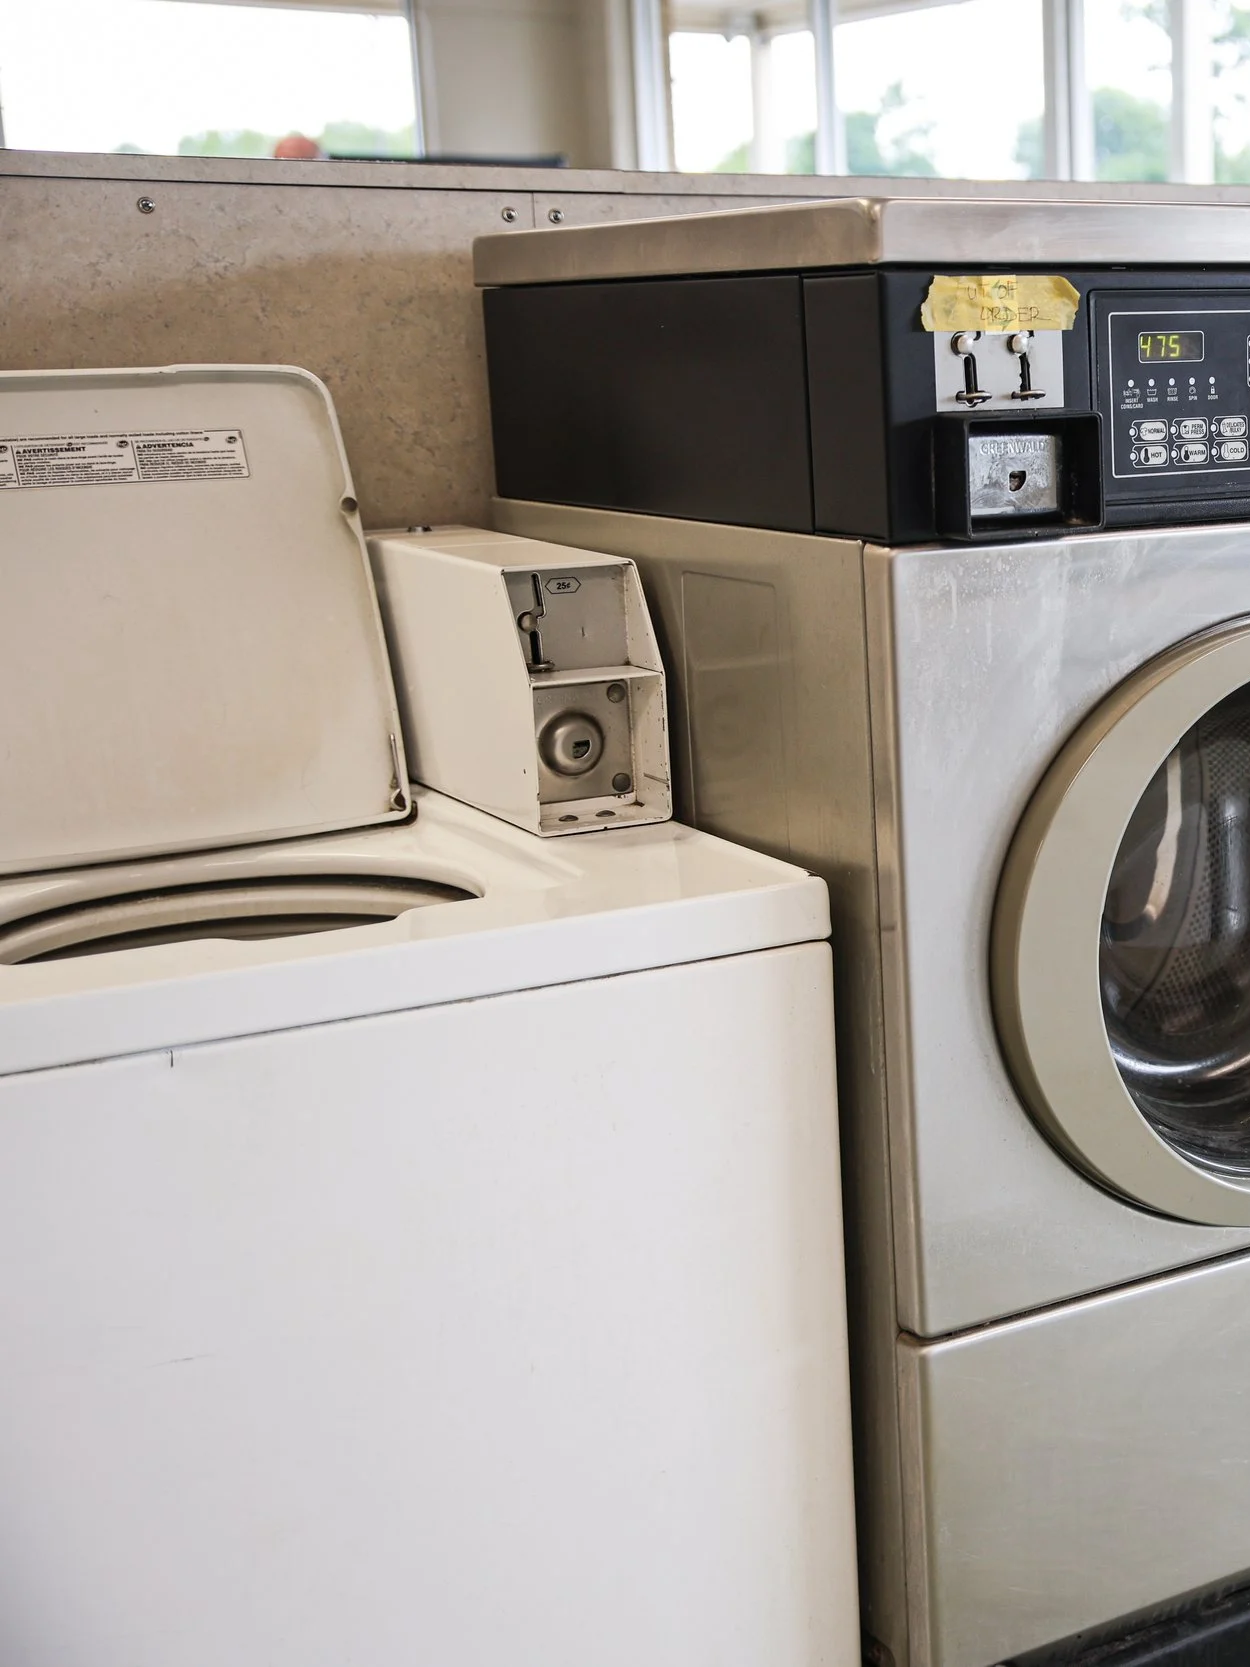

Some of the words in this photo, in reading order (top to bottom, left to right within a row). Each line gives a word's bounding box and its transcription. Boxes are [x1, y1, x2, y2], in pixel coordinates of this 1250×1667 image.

[1140, 335, 1180, 358] 475
[22, 446, 86, 454] AVERTISSEMENT
[142, 441, 194, 449] ADVERTENCIA
[980, 440, 1045, 455] GREENWALD
[556, 581, 571, 591] 25¢
